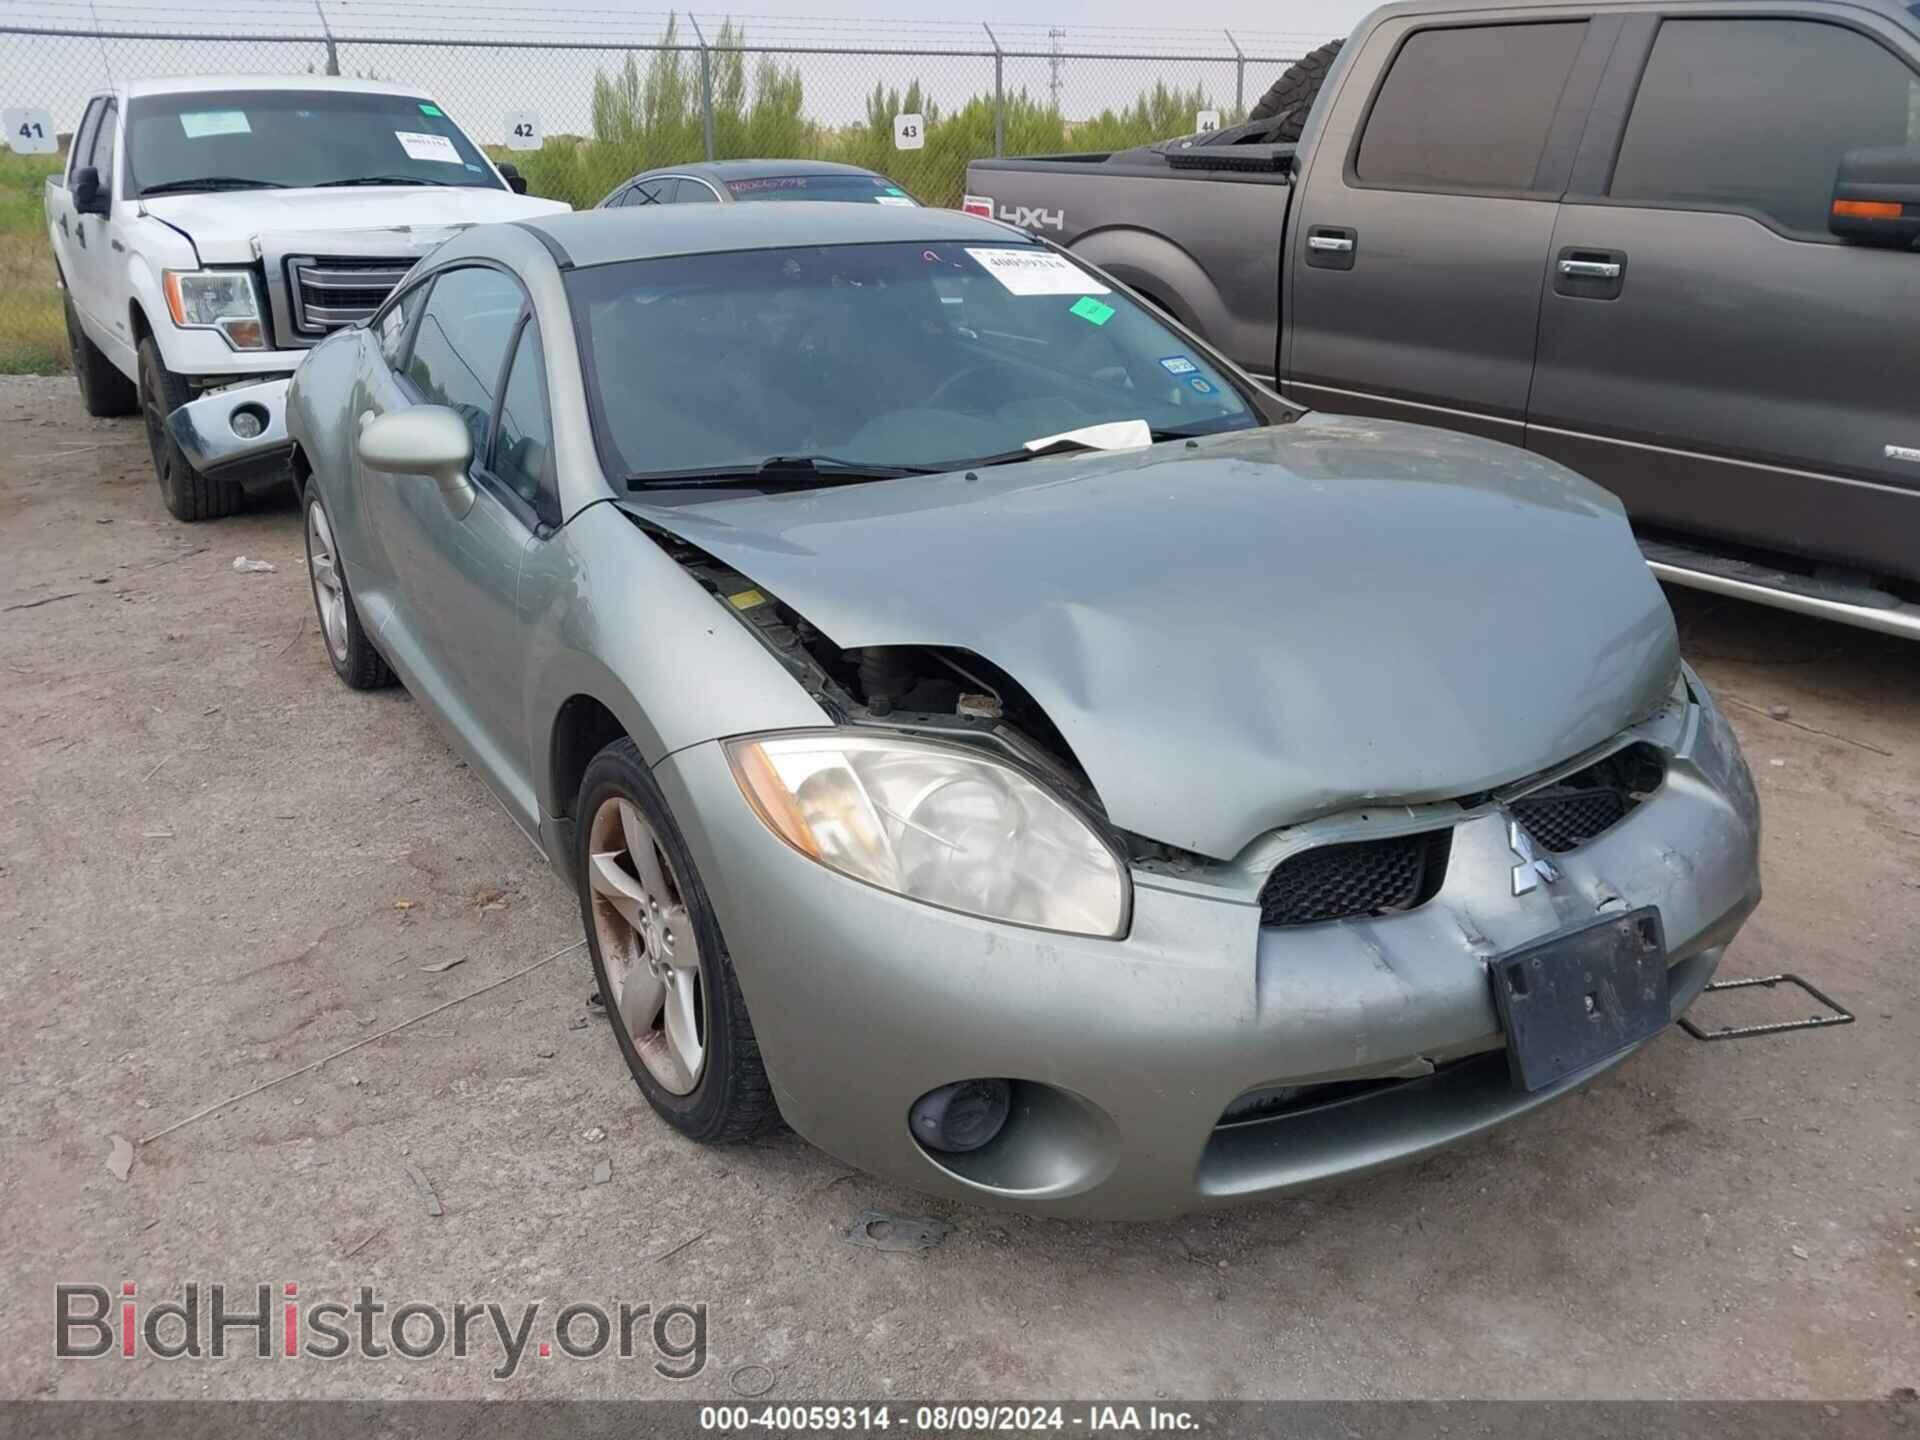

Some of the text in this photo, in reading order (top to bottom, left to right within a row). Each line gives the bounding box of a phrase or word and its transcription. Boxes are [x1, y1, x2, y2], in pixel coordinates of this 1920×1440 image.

[19, 122, 44, 138] 41
[514, 123, 534, 137] 42
[902, 125, 917, 137] 43
[1000, 205, 1064, 231] 4X4
